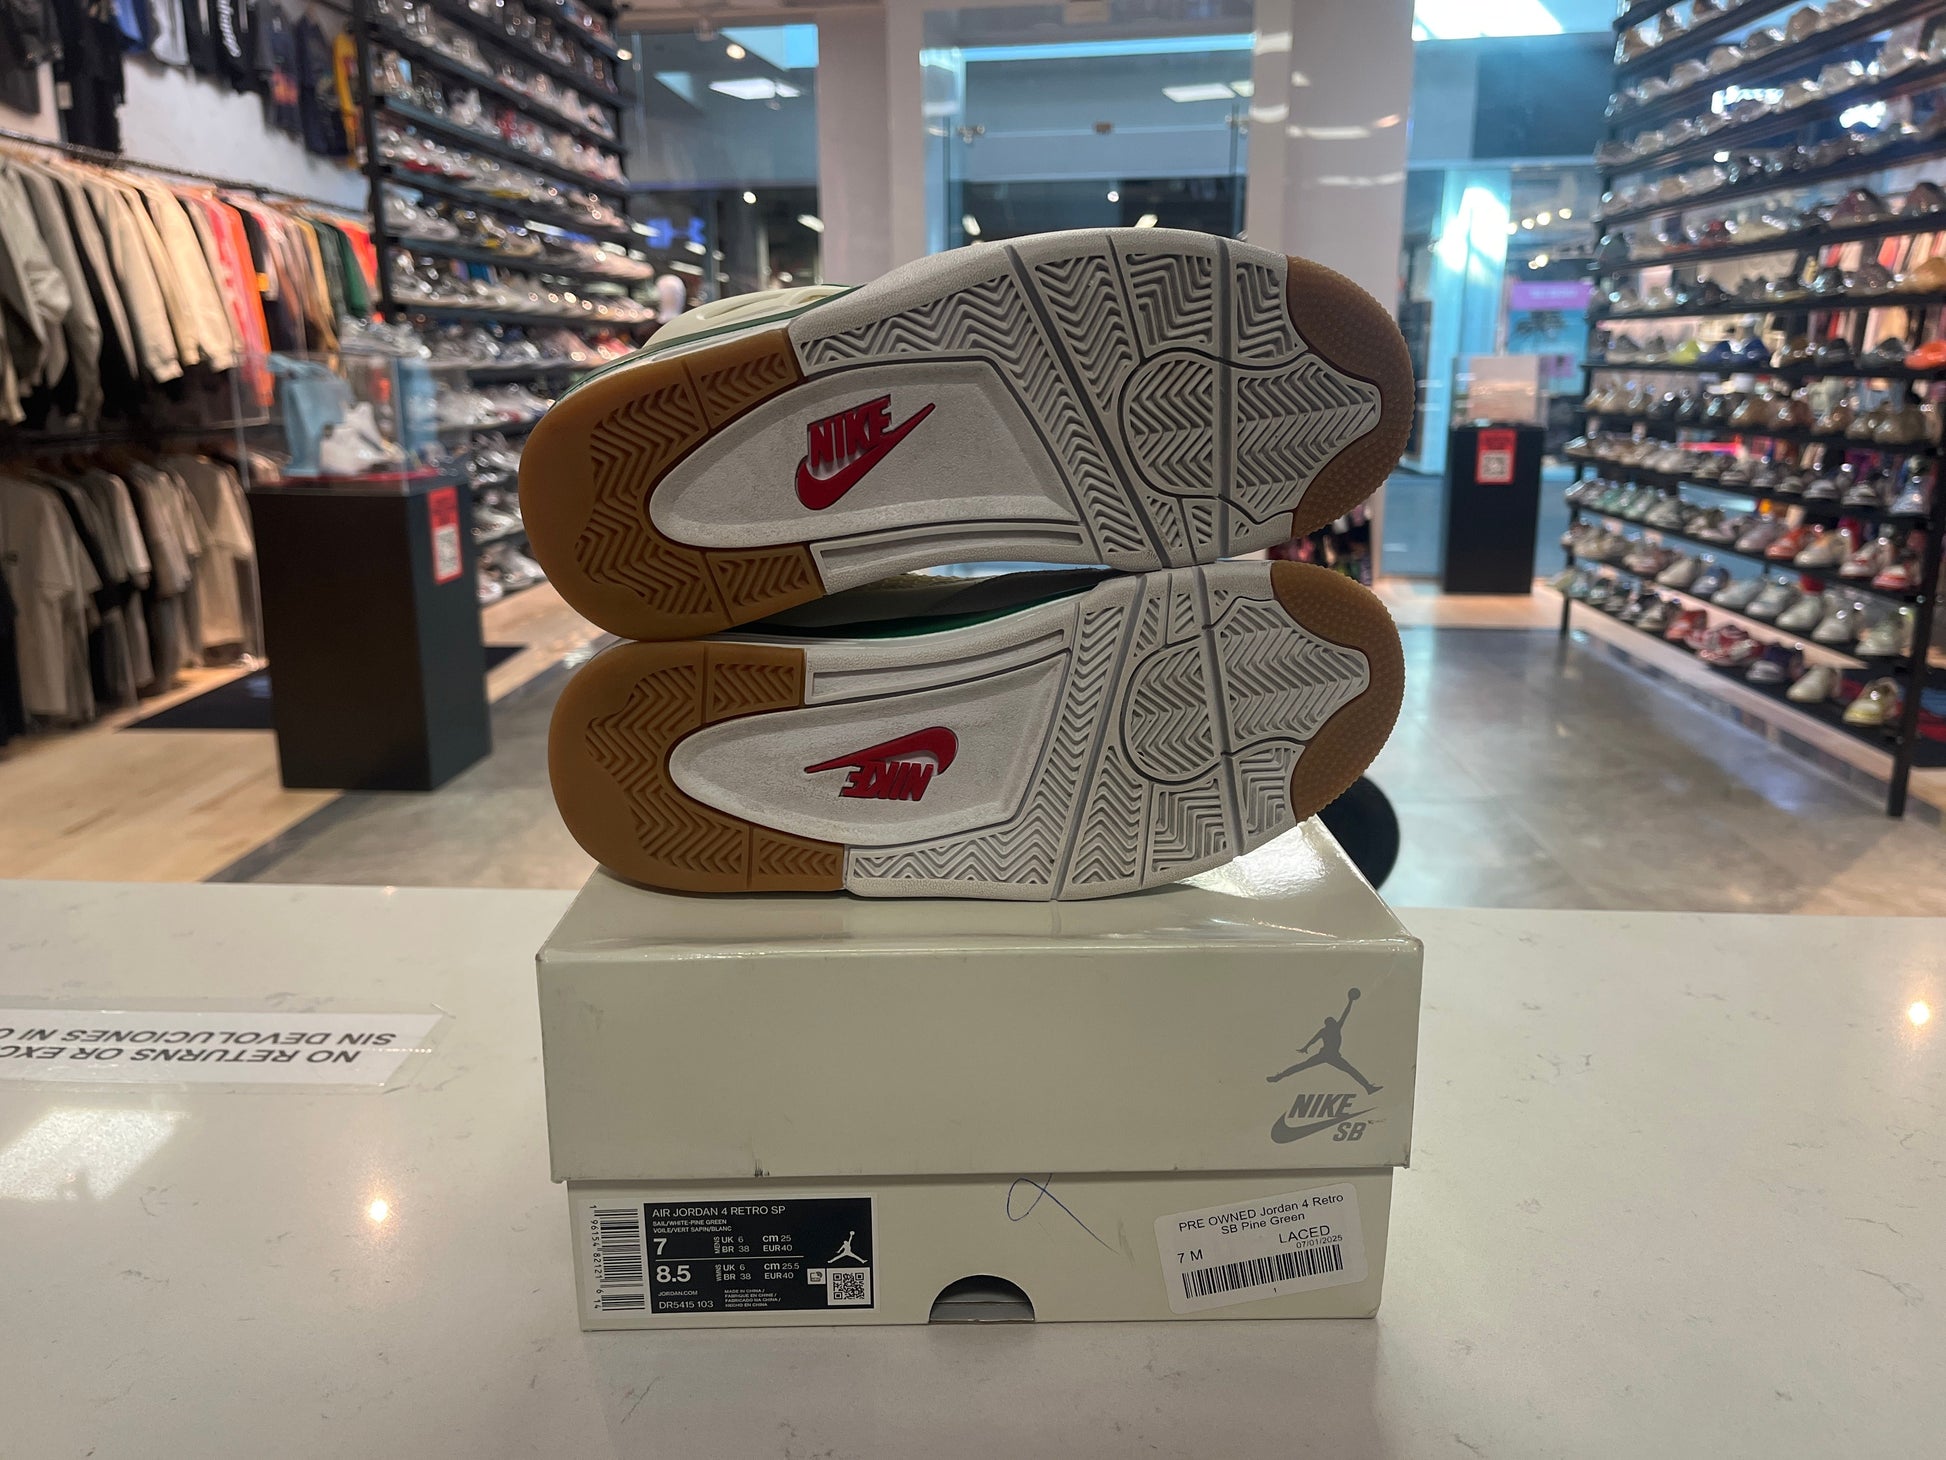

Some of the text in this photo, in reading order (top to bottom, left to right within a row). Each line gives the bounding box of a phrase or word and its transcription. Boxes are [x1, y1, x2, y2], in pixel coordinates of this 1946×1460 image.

[807, 393, 892, 469] NIKE
[839, 760, 934, 801] NIKE
[17, 1028, 59, 1041] NI
[61, 1029, 332, 1045] DEVOLUCIONES
[337, 1032, 398, 1046] SIN
[69, 1048, 124, 1060] OR
[130, 1048, 301, 1063] RETURNS
[306, 1049, 361, 1063] NO
[1288, 1093, 1357, 1119] NIKE
[1332, 1121, 1367, 1142] SB
[652, 1205, 786, 1218] AIR JORDAN 4 RETRO SP
[1178, 1194, 1344, 1232] PRE OWNED Jordan 4 Retro
[1221, 1212, 1306, 1235] SB Pine Green
[590, 1219, 600, 1247] 96154
[721, 1236, 734, 1244] UK
[762, 1235, 779, 1243] cm
[1278, 1225, 1331, 1244] LACED
[653, 1238, 667, 1255] 7
[738, 1245, 750, 1253] 38
[1296, 1234, 1344, 1249] 07/01/2025
[1177, 1249, 1203, 1264] 7 M
[593, 1252, 602, 1279] 82121
[723, 1264, 736, 1272] UK
[763, 1262, 800, 1270] cm 25.5
[656, 1265, 691, 1283] 8.5
[723, 1273, 736, 1281] BR
[659, 1300, 714, 1309] DR5415 103
